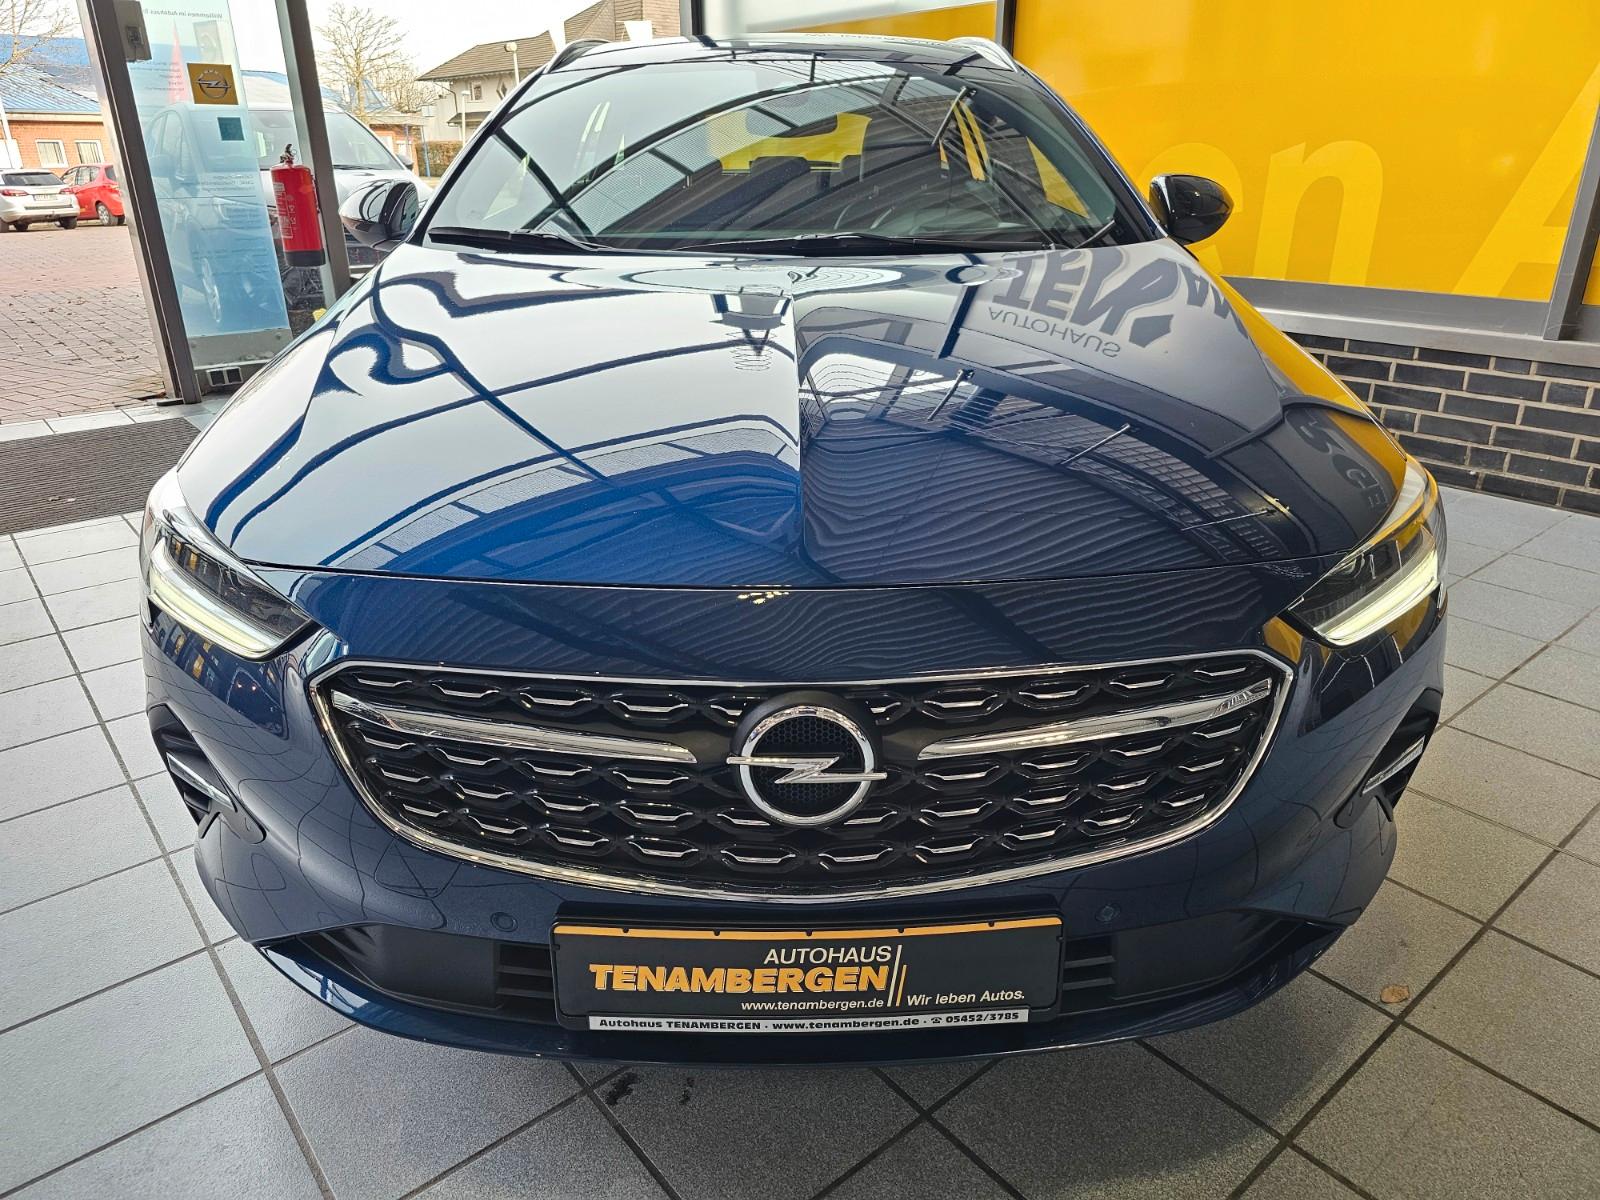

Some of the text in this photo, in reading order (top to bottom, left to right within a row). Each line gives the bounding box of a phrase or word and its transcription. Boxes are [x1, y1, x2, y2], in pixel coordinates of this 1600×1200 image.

[764, 945, 892, 965] AUTOHAUS
[588, 963, 890, 994] TENAMBERGEN
[741, 998, 884, 1011] www.tenambergen.de
[907, 988, 1025, 1006] Wir leben Autos.
[599, 1011, 1019, 1030] Autohaus TENAMBERGEN www.tenambergen.de 05452/3785
